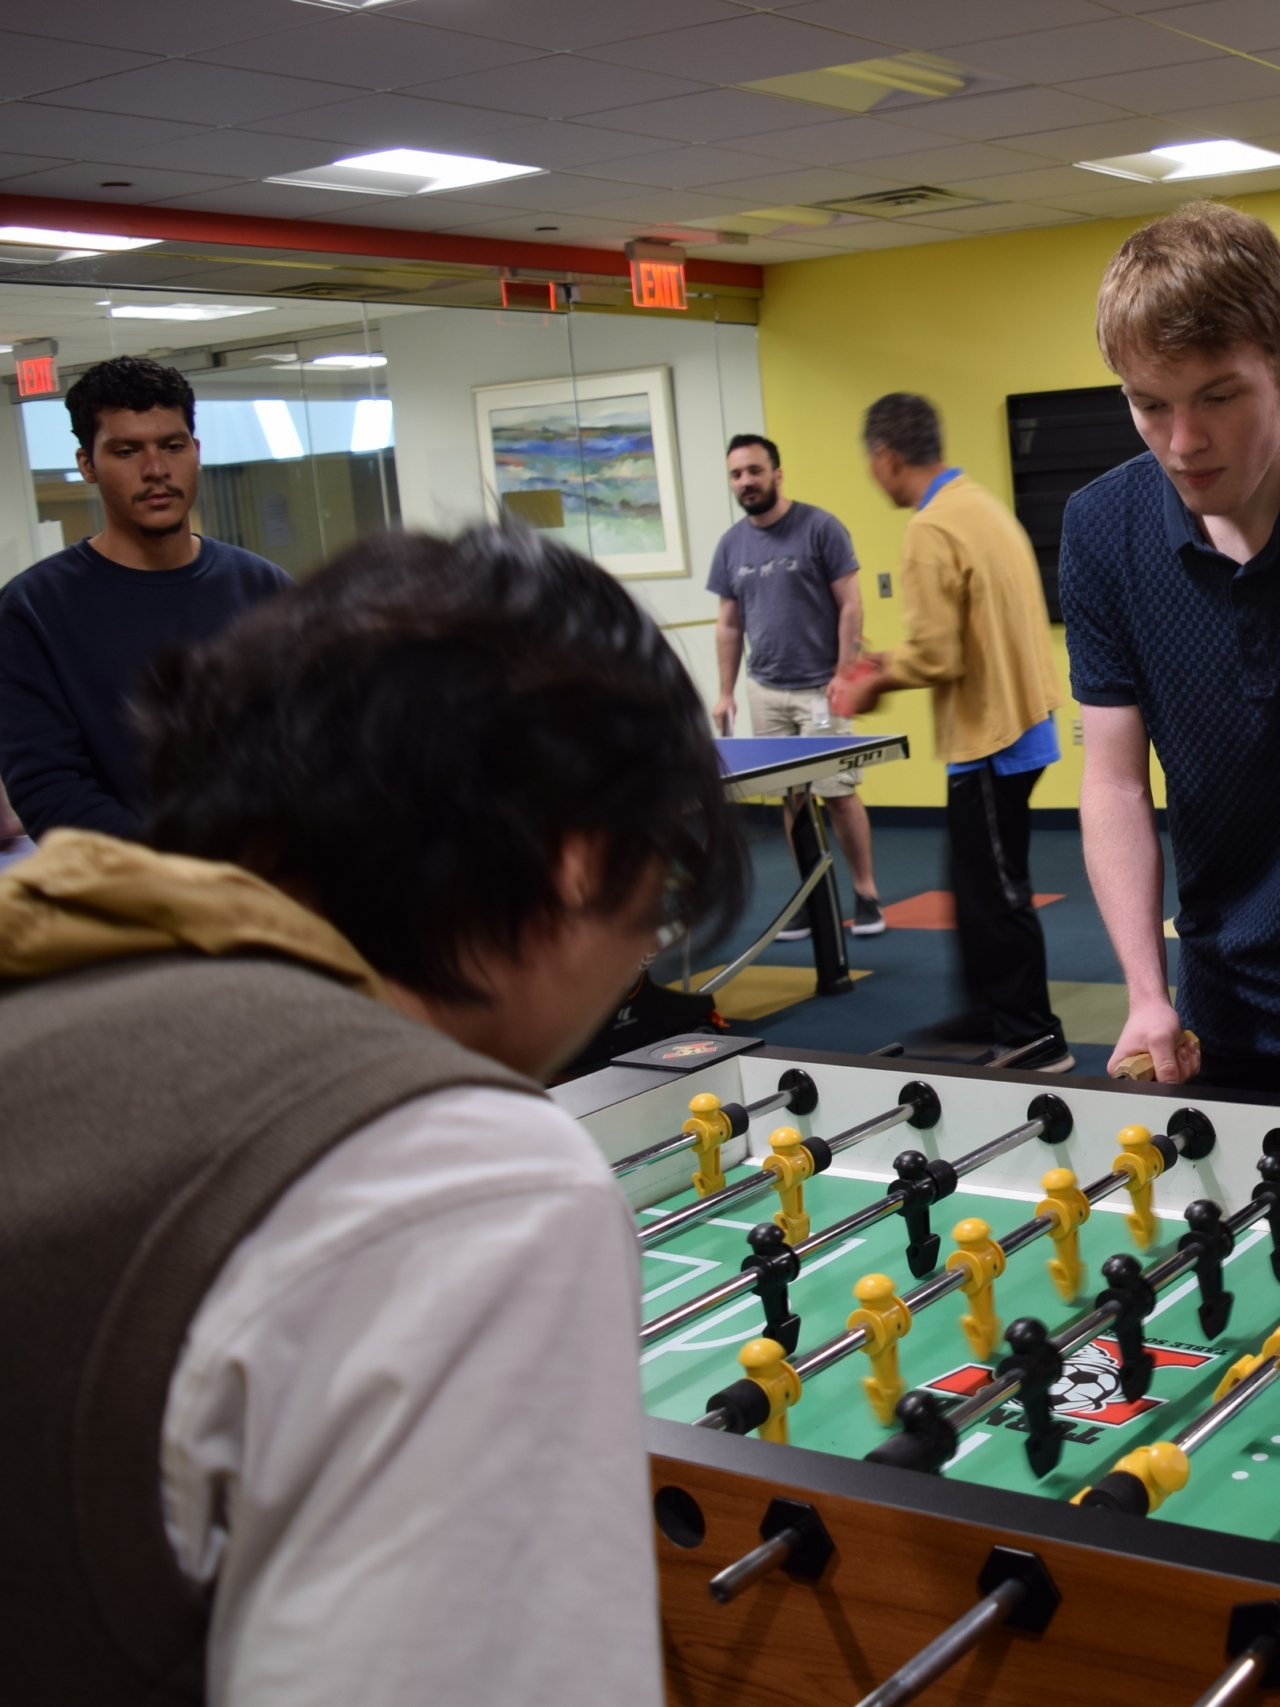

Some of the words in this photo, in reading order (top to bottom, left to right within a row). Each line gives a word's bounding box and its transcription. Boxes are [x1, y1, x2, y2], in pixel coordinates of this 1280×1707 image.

[640, 263, 680, 307] EXIT
[22, 357, 53, 395] EXIT
[1169, 1341, 1229, 1356] TABLE
